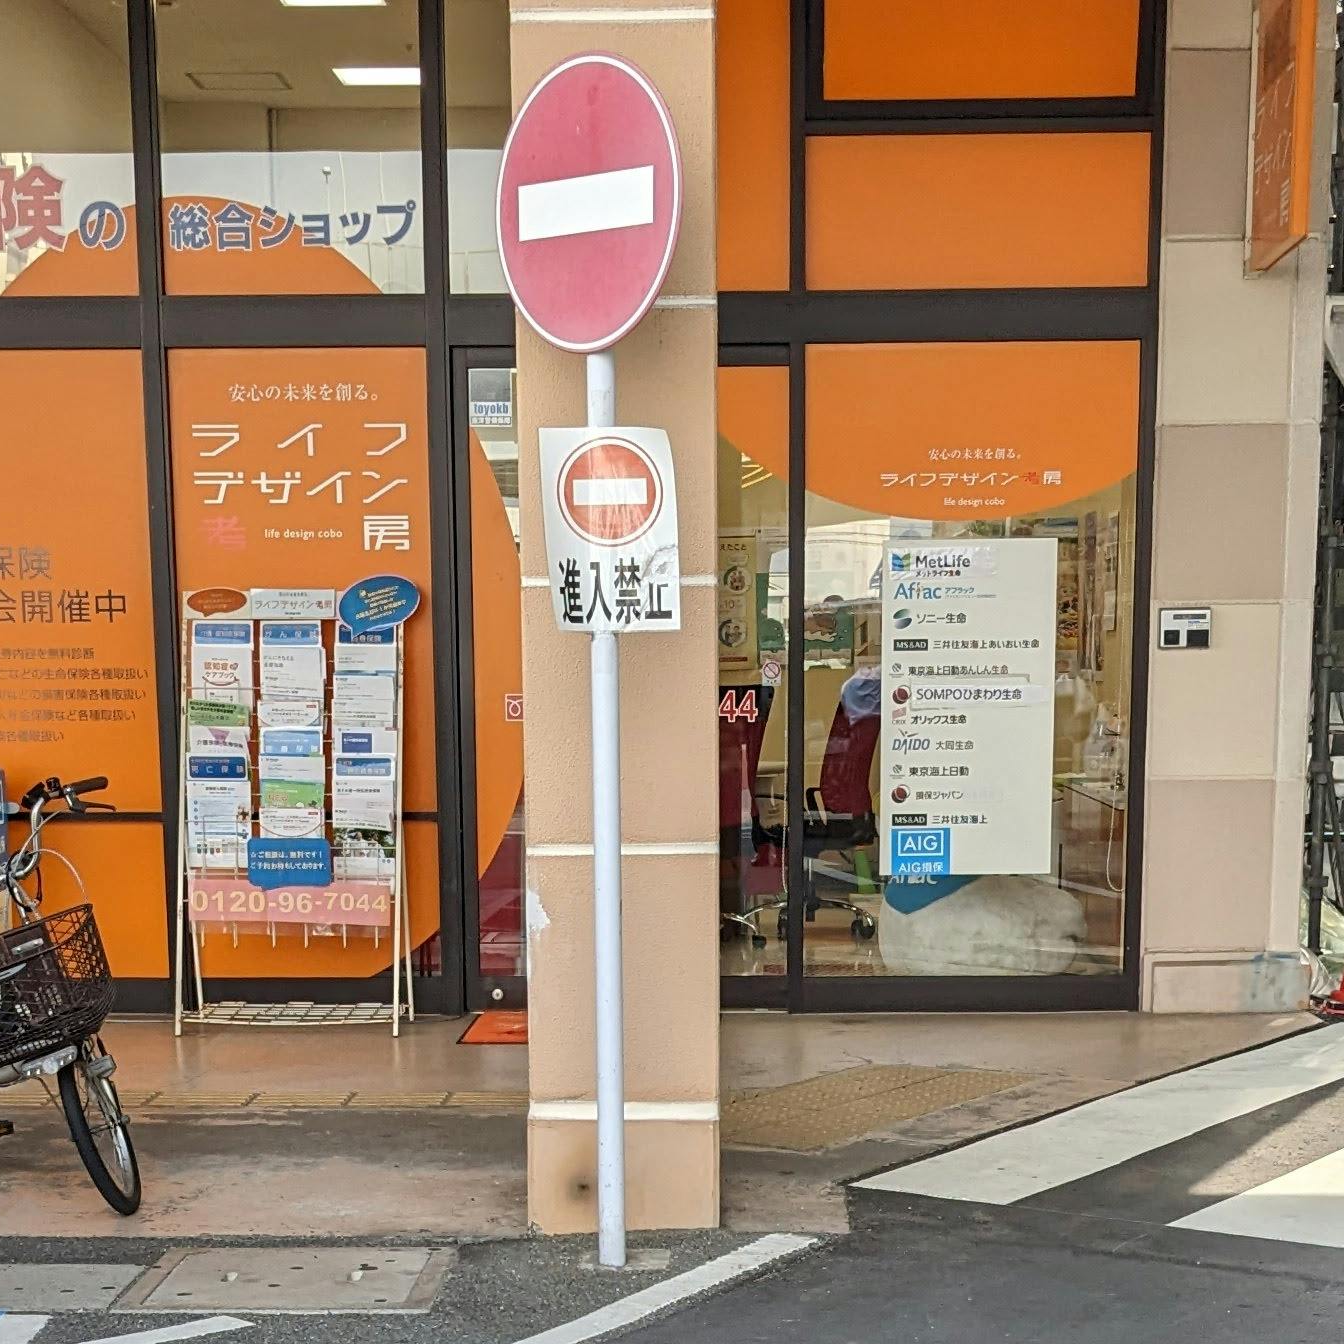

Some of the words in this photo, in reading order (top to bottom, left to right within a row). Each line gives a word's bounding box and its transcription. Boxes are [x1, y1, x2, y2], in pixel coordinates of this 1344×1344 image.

[228, 383, 380, 402] 安心の未来を創る。
[191, 422, 407, 457] ライフ
[193, 471, 408, 504] デザイン
[943, 498, 956, 506] life
[958, 498, 983, 508] design
[985, 497, 1005, 506] cobo
[264, 528, 281, 539] life
[283, 528, 315, 541] design
[317, 528, 343, 539] cobo
[915, 555, 971, 568] MetLife
[558, 557, 673, 625] 進入禁止
[893, 582, 942, 600] Aflac
[916, 612, 967, 624] ソニー生命
[895, 640, 927, 649] MS&AD
[932, 638, 1040, 649] 三井住友海上あいおい生命
[908, 664, 1009, 676] 東京海上日動あんしん生命
[916, 688, 1023, 701] SOMPOひまわり生命
[719, 689, 758, 722] 44
[910, 714, 967, 725] オリックス生命
[892, 734, 931, 753] DAIDO
[935, 740, 974, 751] 大同生命
[908, 766, 969, 777] 東京海上日動
[915, 791, 964, 800] 損保ジャパン
[894, 816, 926, 824] MS&AD
[931, 814, 988, 825] 三井住友海上
[903, 835, 938, 851] AIG
[898, 861, 944, 873] AIG損保
[192, 890, 388, 913] 0120-96-7044
